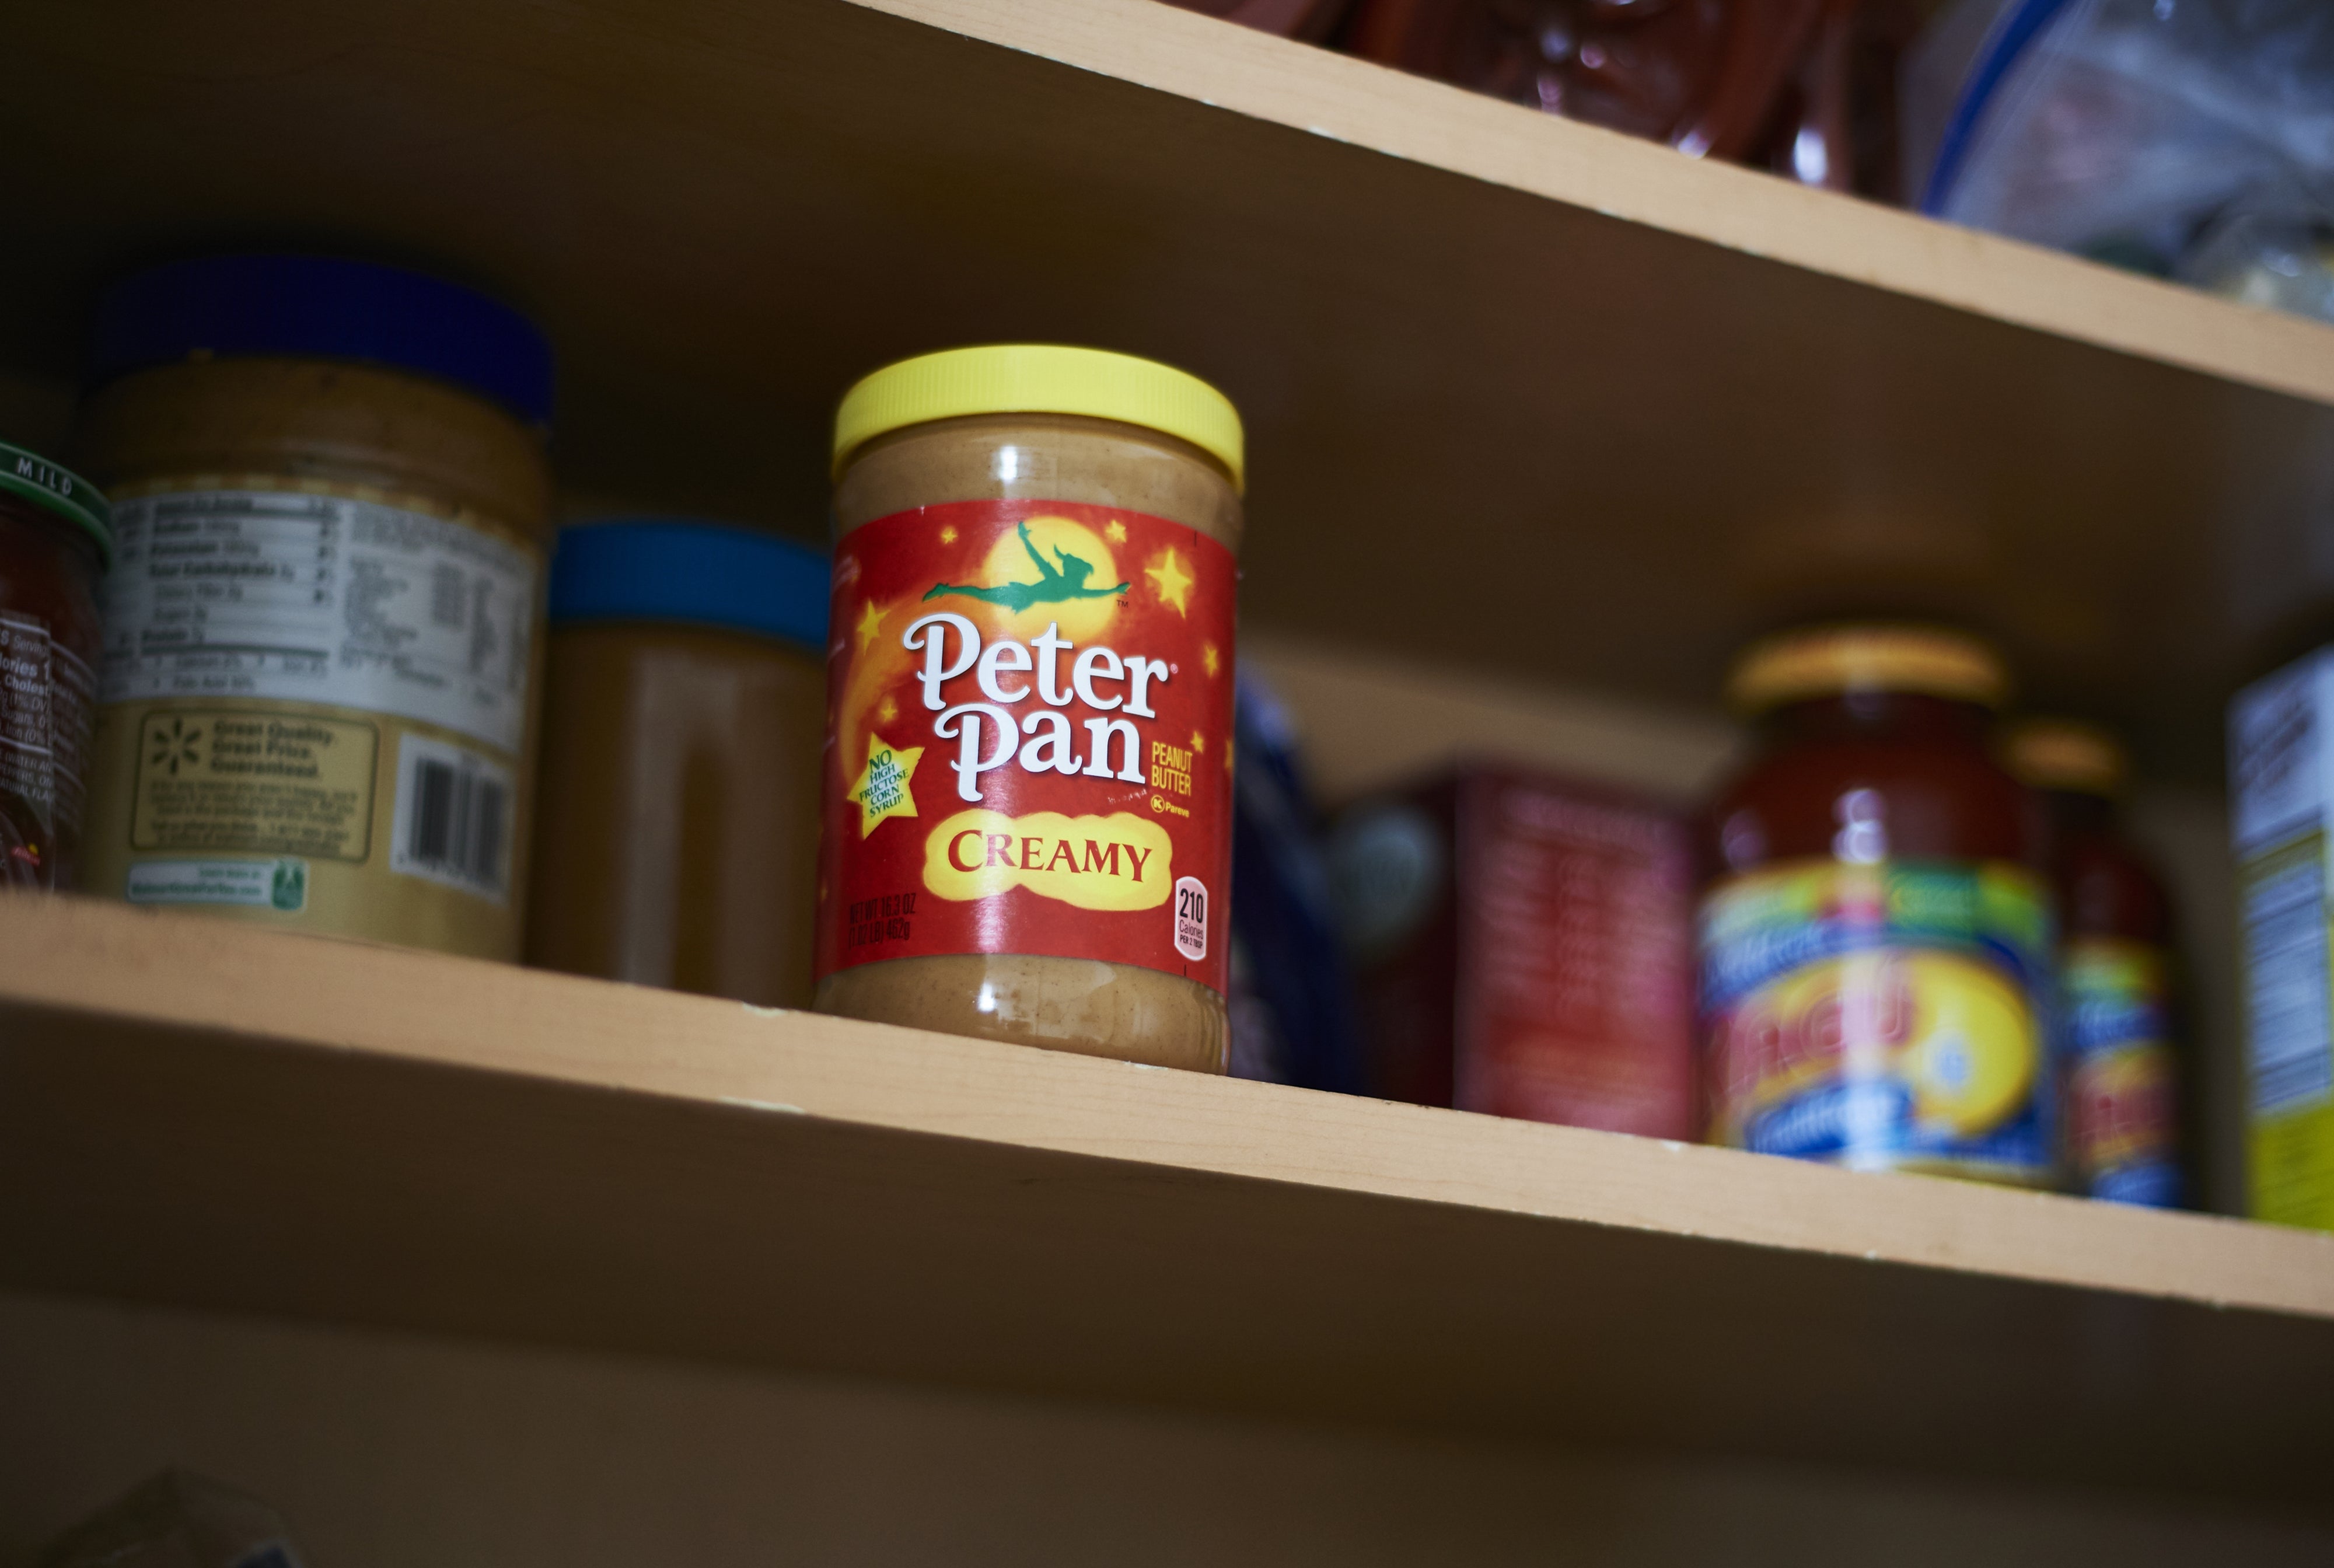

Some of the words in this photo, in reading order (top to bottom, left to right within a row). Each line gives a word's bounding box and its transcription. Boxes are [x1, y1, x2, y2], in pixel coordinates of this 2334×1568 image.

[17, 457, 72, 496] MILD
[903, 612, 1169, 719] Peter
[869, 749, 892, 774] NO
[1152, 741, 1193, 773] PEANUT
[859, 768, 909, 802] FRUCTOSE
[870, 763, 895, 784] HIGH
[1151, 764, 1192, 796] BUTTER
[869, 793, 904, 818] SYRUP
[871, 784, 900, 805] CORN
[1165, 801, 1190, 818] Pareve
[948, 829, 1152, 883] CREAMY
[850, 902, 864, 925] NET
[865, 898, 878, 921] WT
[881, 895, 900, 918] 16.3
[903, 892, 917, 914] OZ
[1180, 888, 1204, 924] 210
[870, 920, 885, 944] LB)
[886, 917, 911, 941] 462g
[1179, 919, 1204, 940] Calories
[1180, 934, 1189, 945] PER
[1189, 937, 1193, 946] 2
[1193, 939, 1203, 949] TBSP
